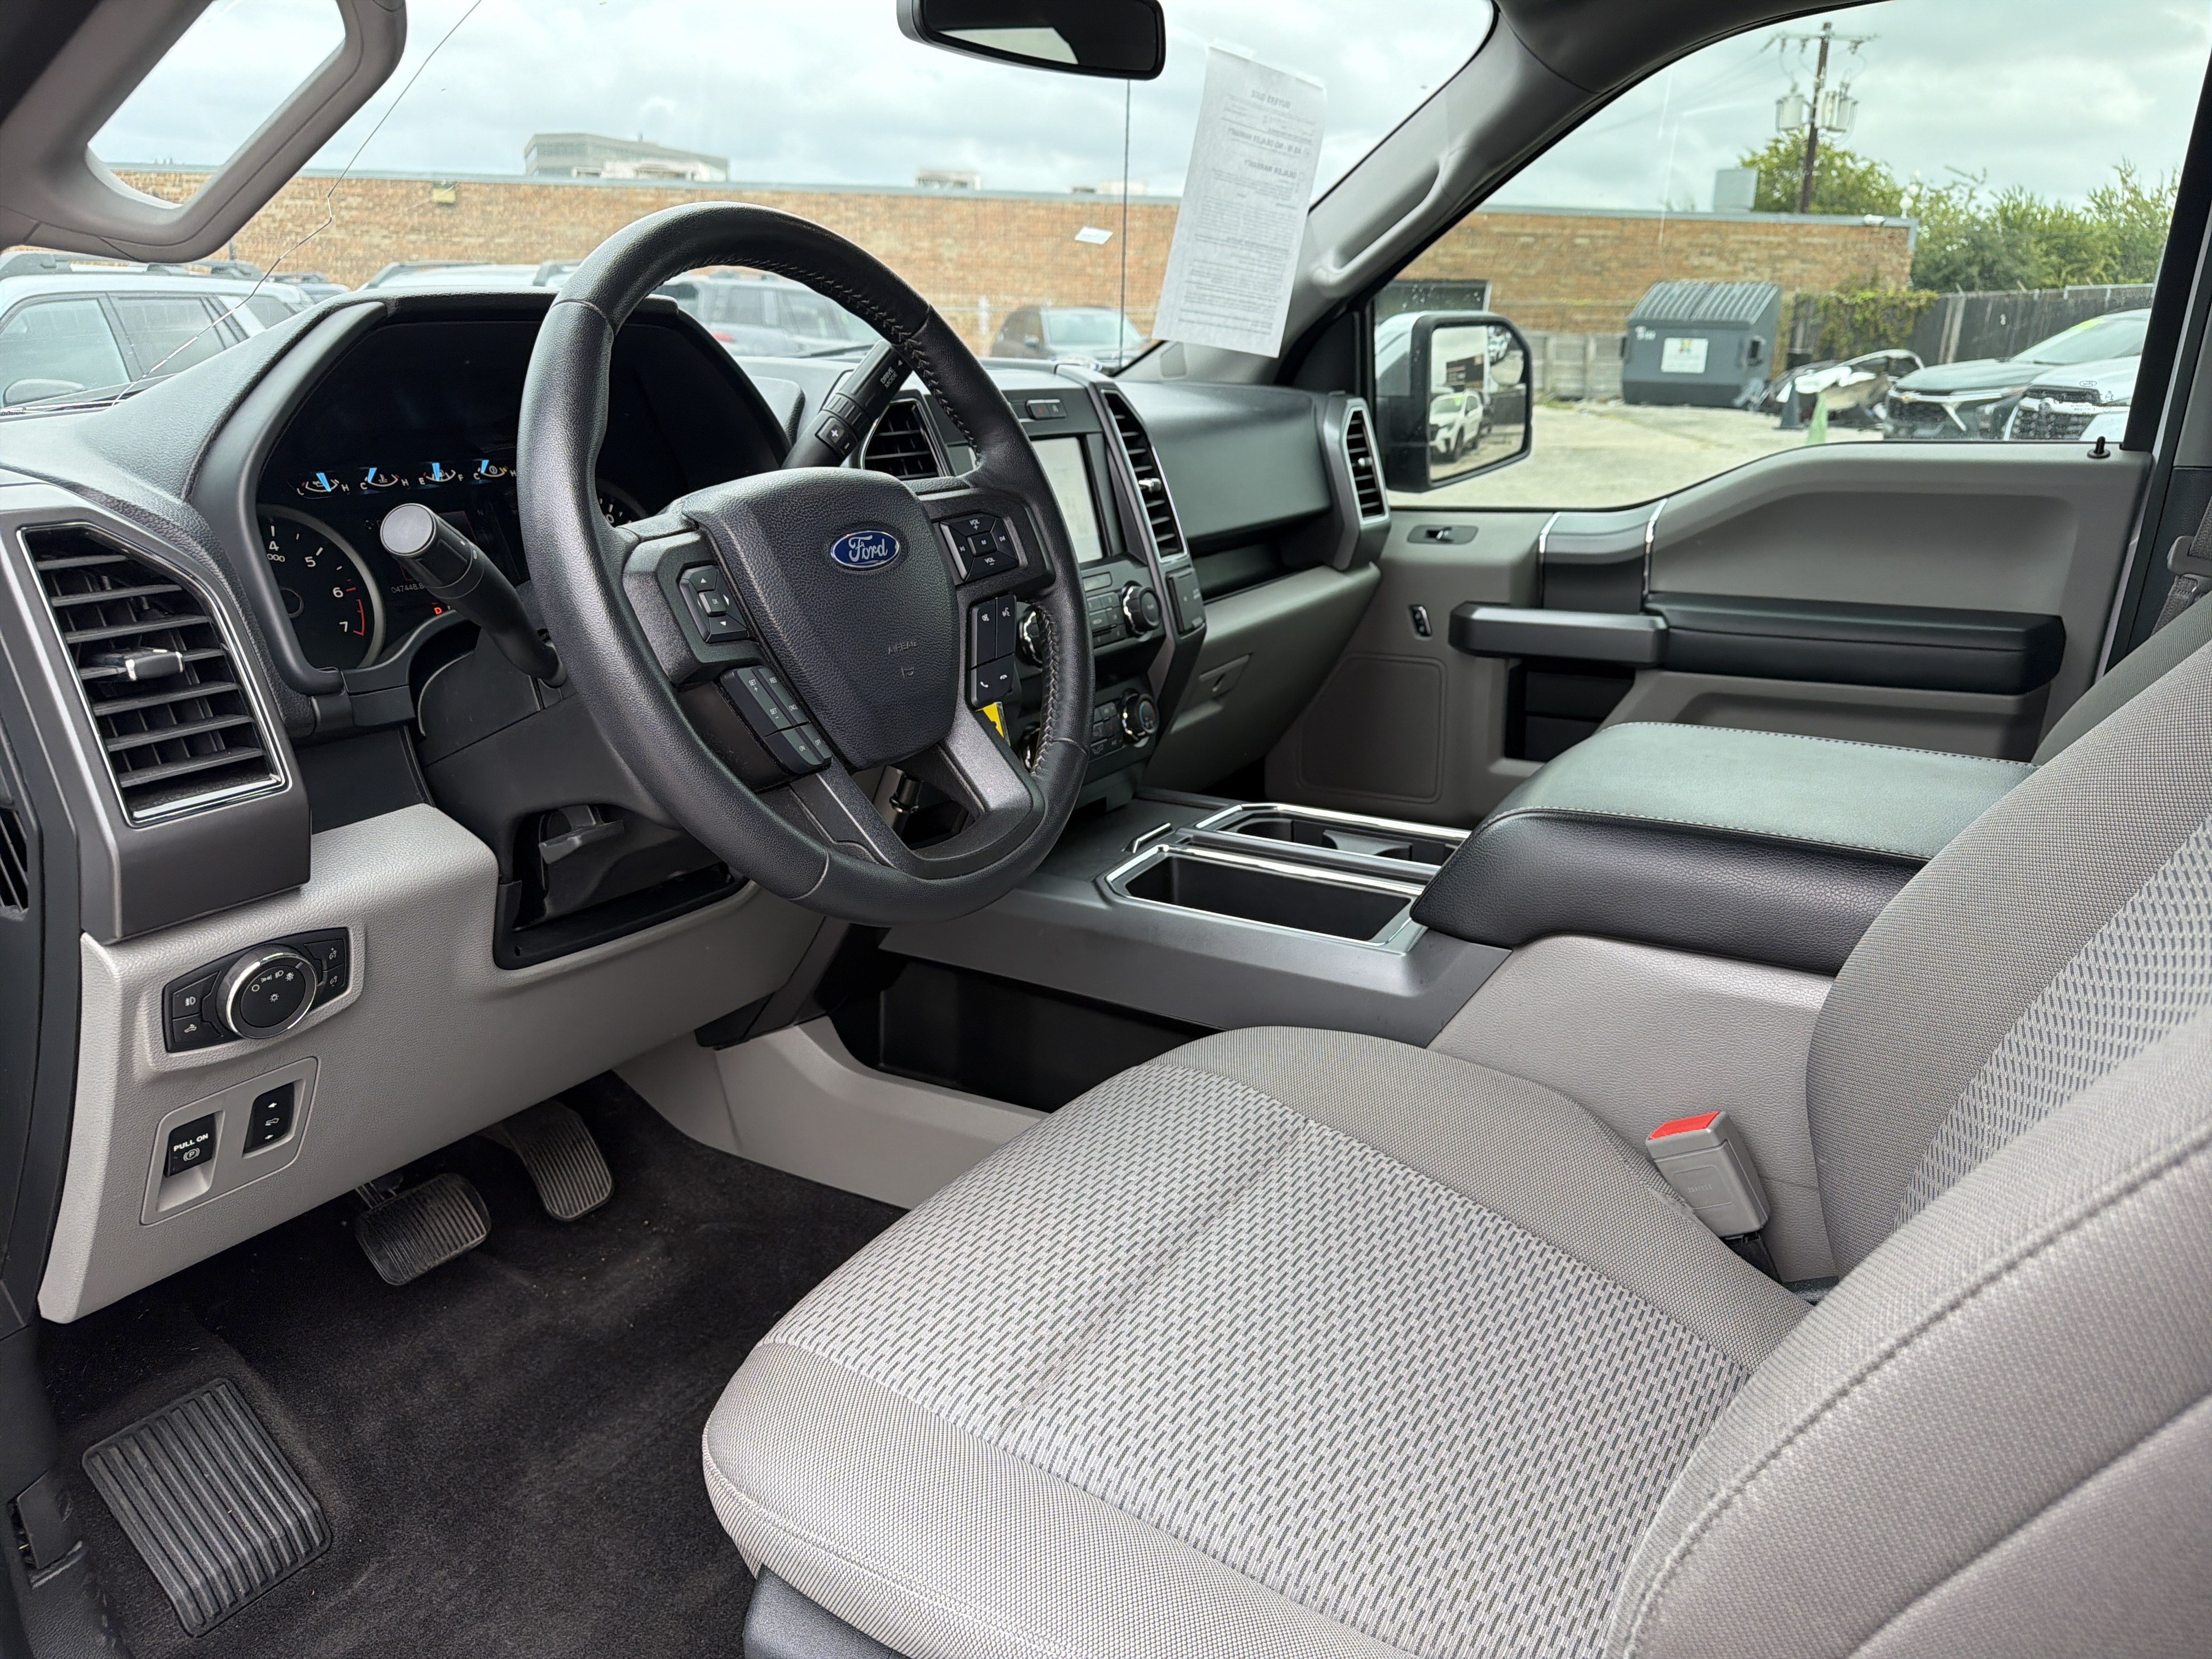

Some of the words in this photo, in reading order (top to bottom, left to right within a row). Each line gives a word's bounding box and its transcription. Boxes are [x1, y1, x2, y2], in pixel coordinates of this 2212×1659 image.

[881, 367, 895, 384] DRIVE
[884, 371, 898, 388] MODE
[458, 473, 464, 482] F
[473, 472, 481, 481] C
[360, 482, 368, 490] C
[401, 478, 409, 487] H
[969, 518, 980, 527] VOL
[269, 540, 280, 551] 4
[848, 534, 888, 562] Ford
[304, 556, 316, 567] 5
[332, 587, 343, 598] 6
[338, 621, 348, 633] 7
[174, 1140, 195, 1152] PULL
[196, 1133, 208, 1142] ON
